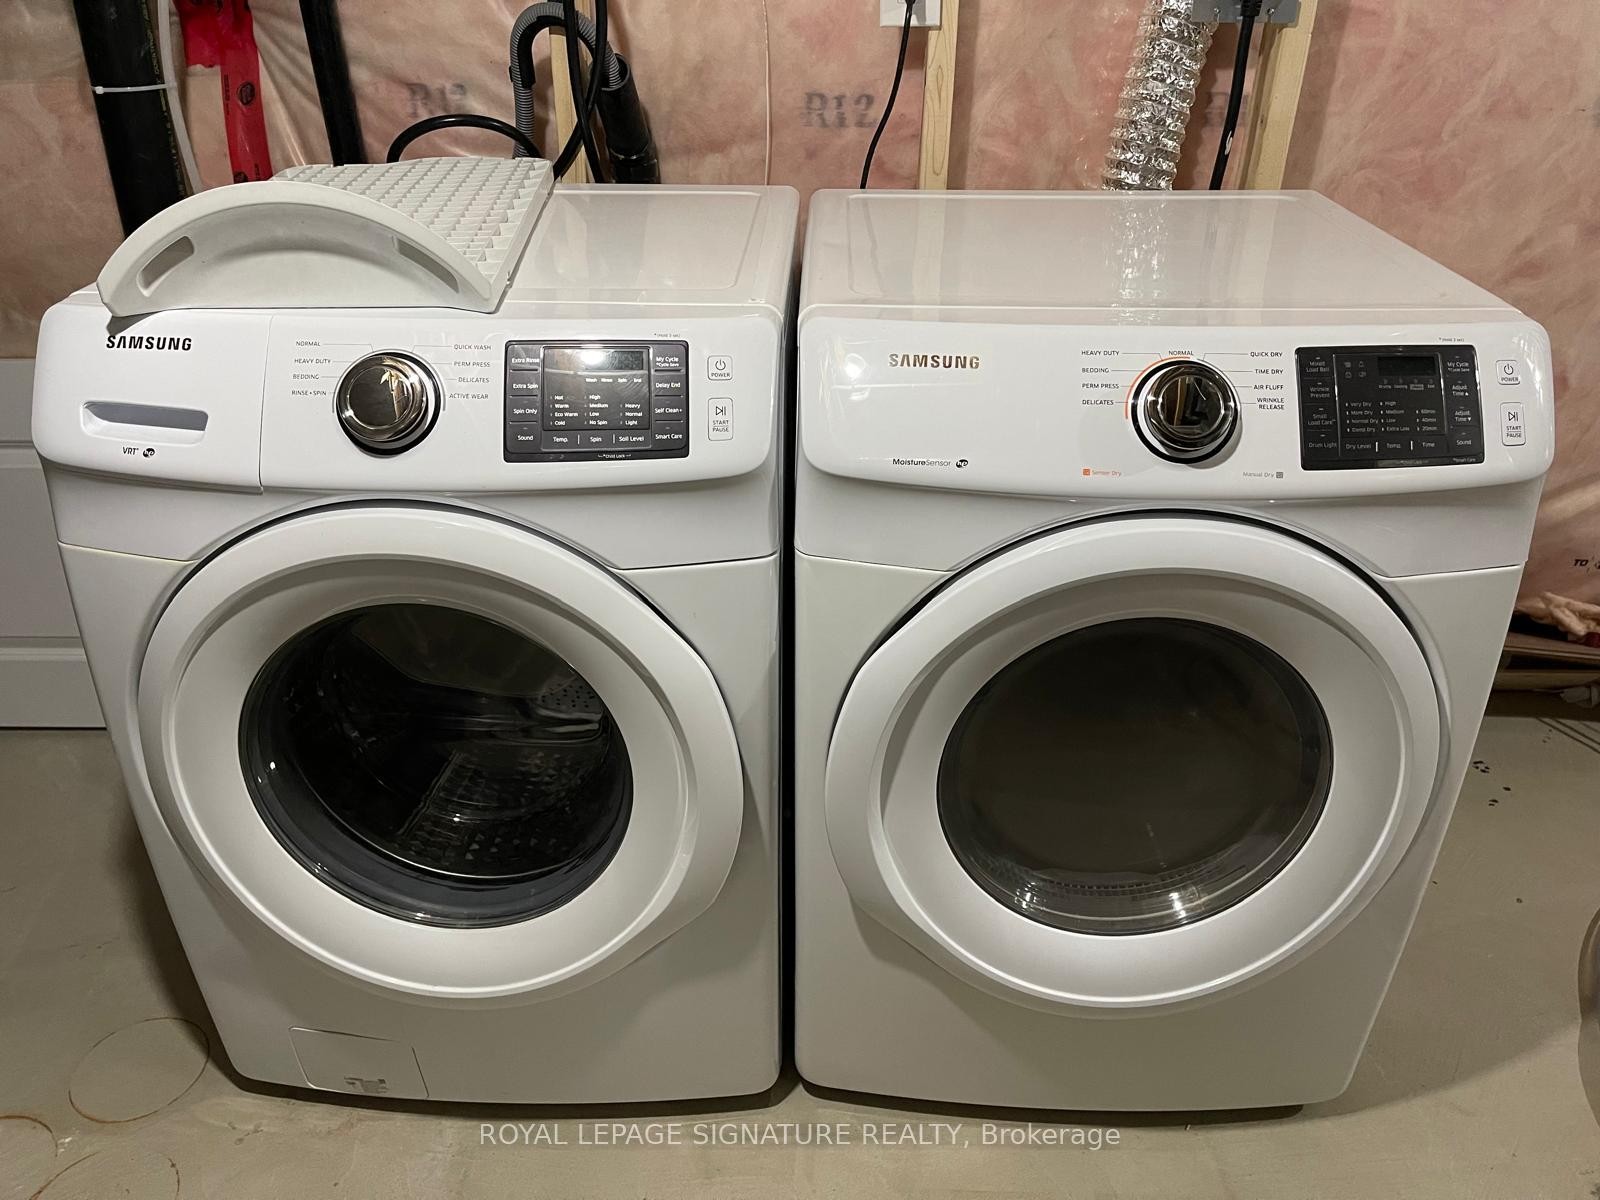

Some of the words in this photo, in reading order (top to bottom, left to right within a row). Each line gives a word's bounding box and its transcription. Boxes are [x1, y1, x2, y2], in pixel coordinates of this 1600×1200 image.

[801, 92, 877, 128] R12
[106, 335, 193, 352] SAMSUNG
[888, 353, 981, 370] SAMSUNG
[892, 458, 951, 467] MoistureSensor
[1111, 469, 1122, 478] Dry
[1264, 471, 1275, 479] Dry
[1574, 558, 1589, 567] TO
